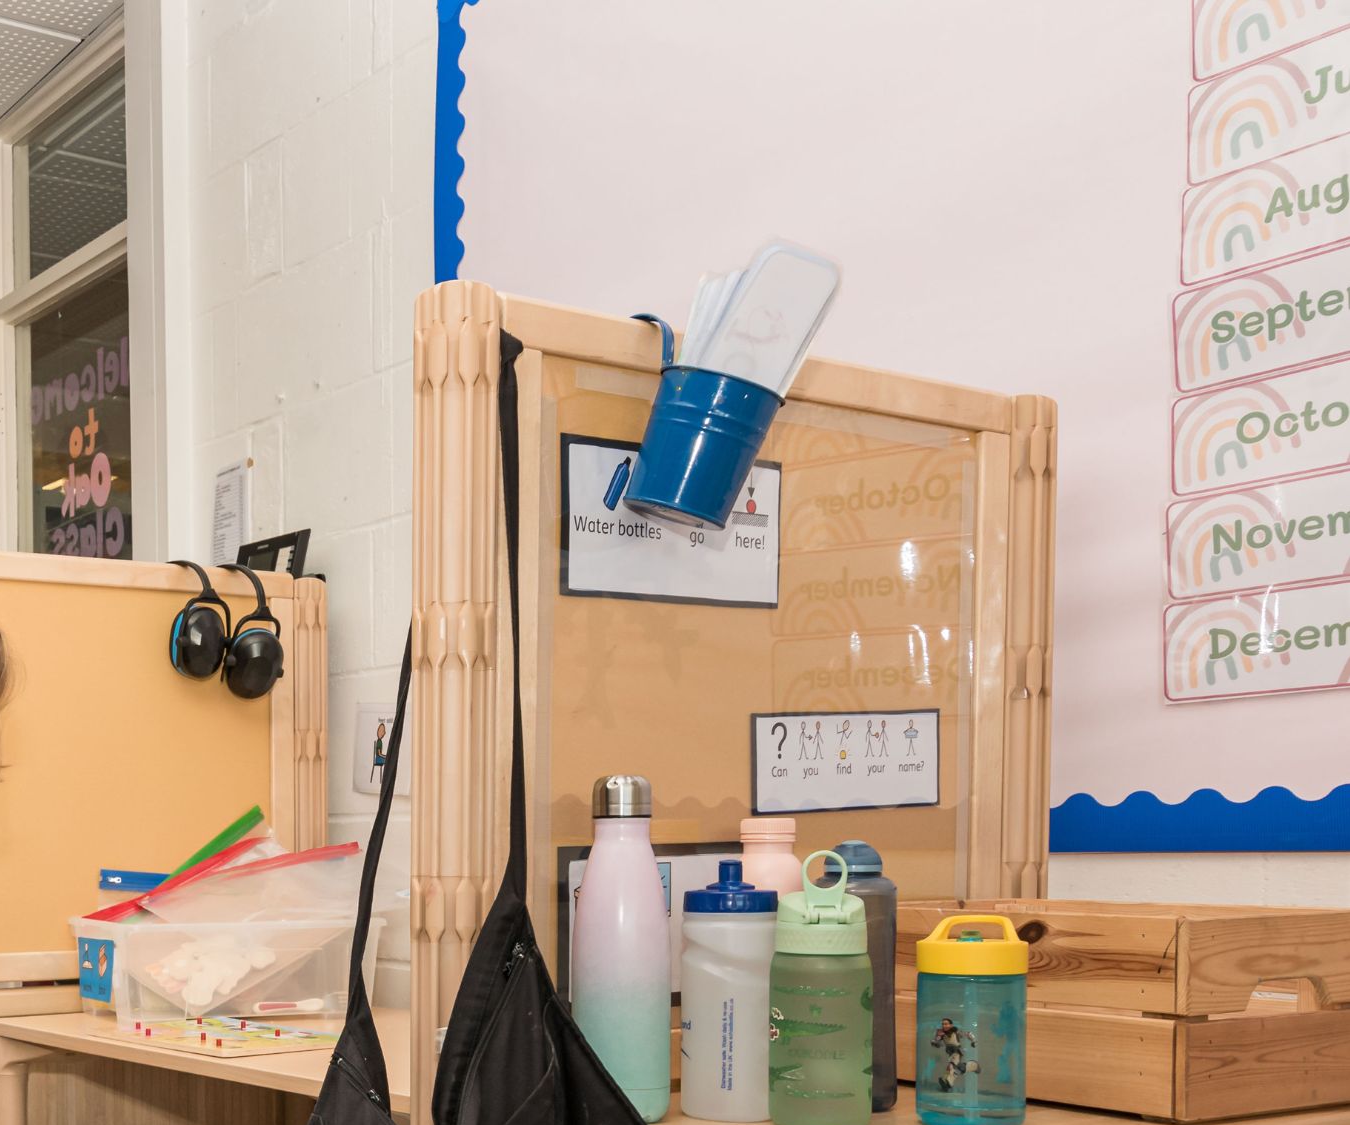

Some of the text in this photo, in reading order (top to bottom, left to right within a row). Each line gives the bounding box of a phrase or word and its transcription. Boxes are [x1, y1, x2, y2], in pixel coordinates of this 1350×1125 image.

[1264, 173, 1350, 224] Aug
[1210, 287, 1350, 344] Septe
[1236, 401, 1350, 444] Octo
[574, 515, 765, 549] Water bottles go here!
[771, 761, 925, 779] Can you find your name?
